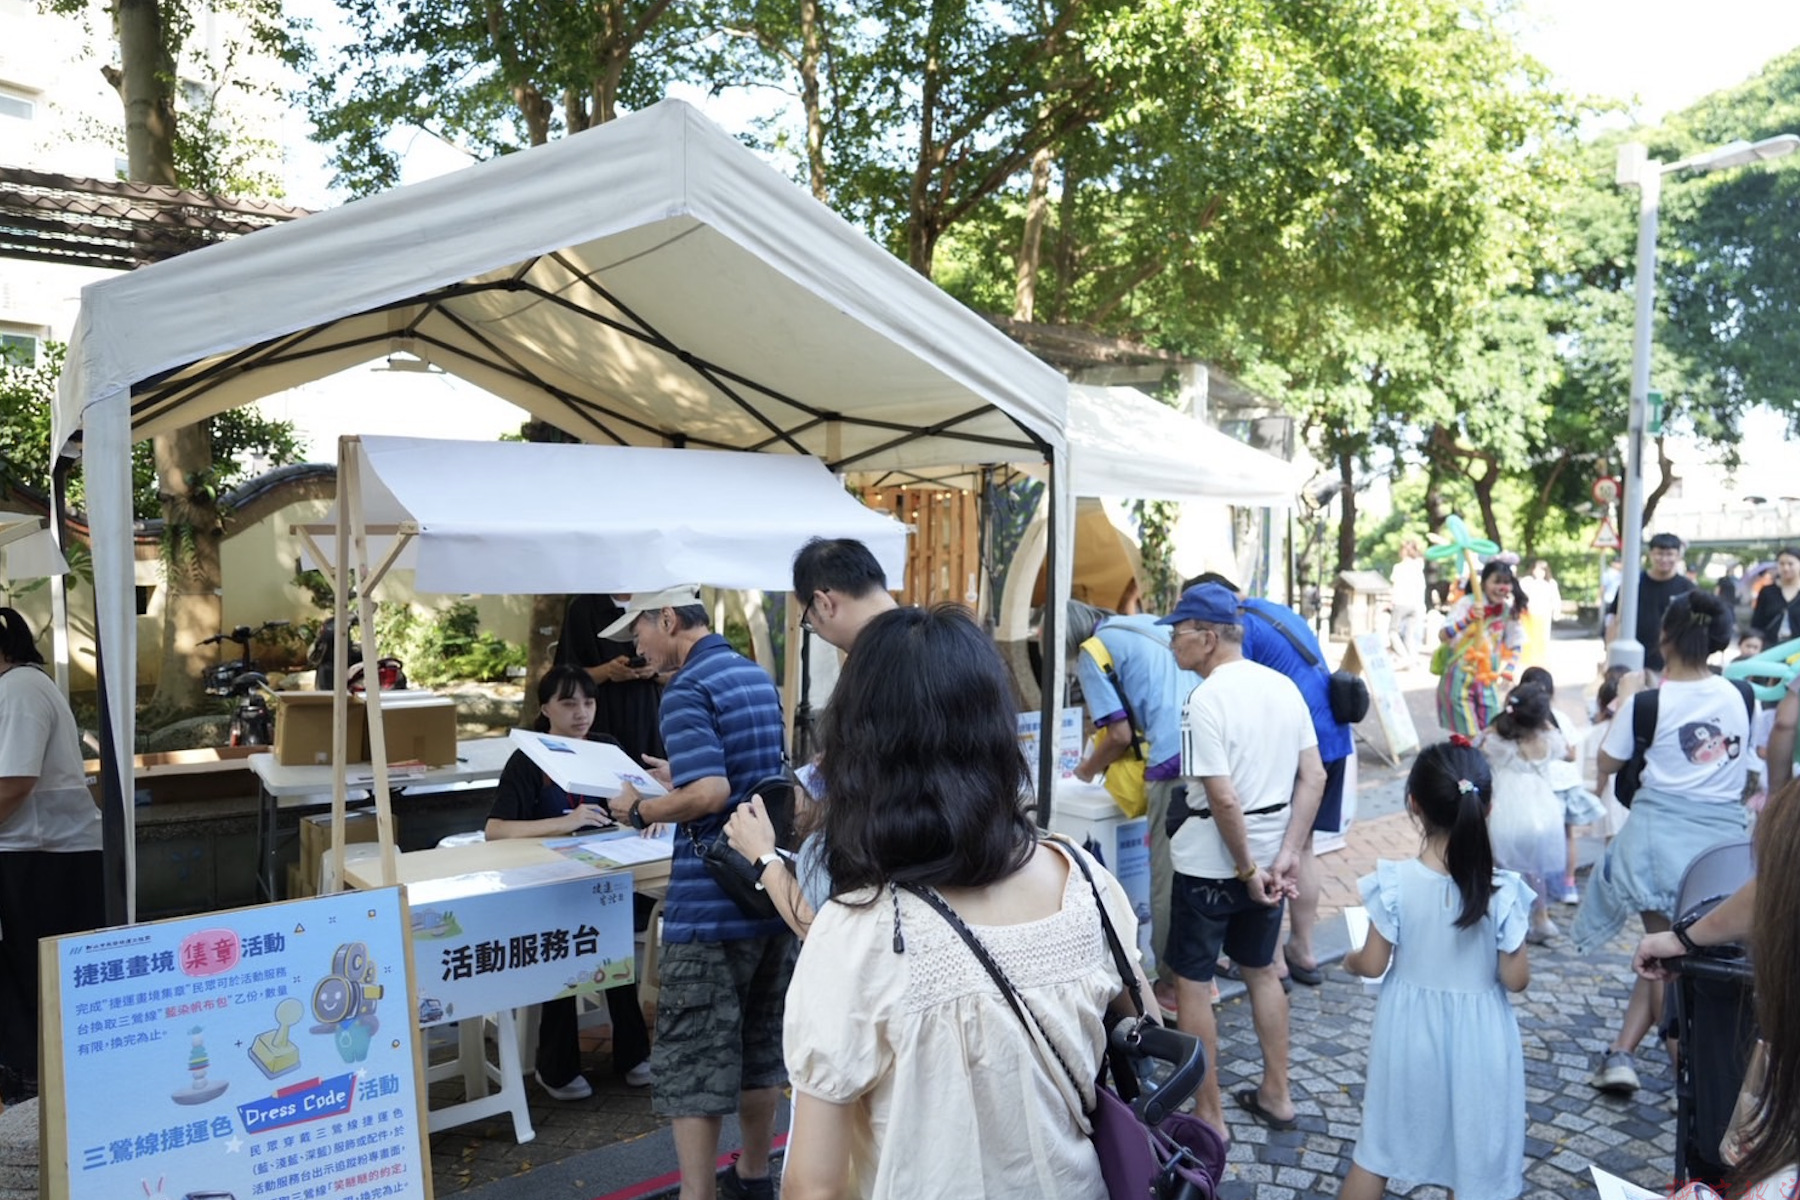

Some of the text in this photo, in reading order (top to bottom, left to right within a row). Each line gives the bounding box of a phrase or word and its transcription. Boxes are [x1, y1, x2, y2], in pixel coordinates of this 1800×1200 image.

[441, 924, 600, 981] 活動服務台
[83, 1074, 399, 1171] 三鶯線捷運色 Dress Code 活動
